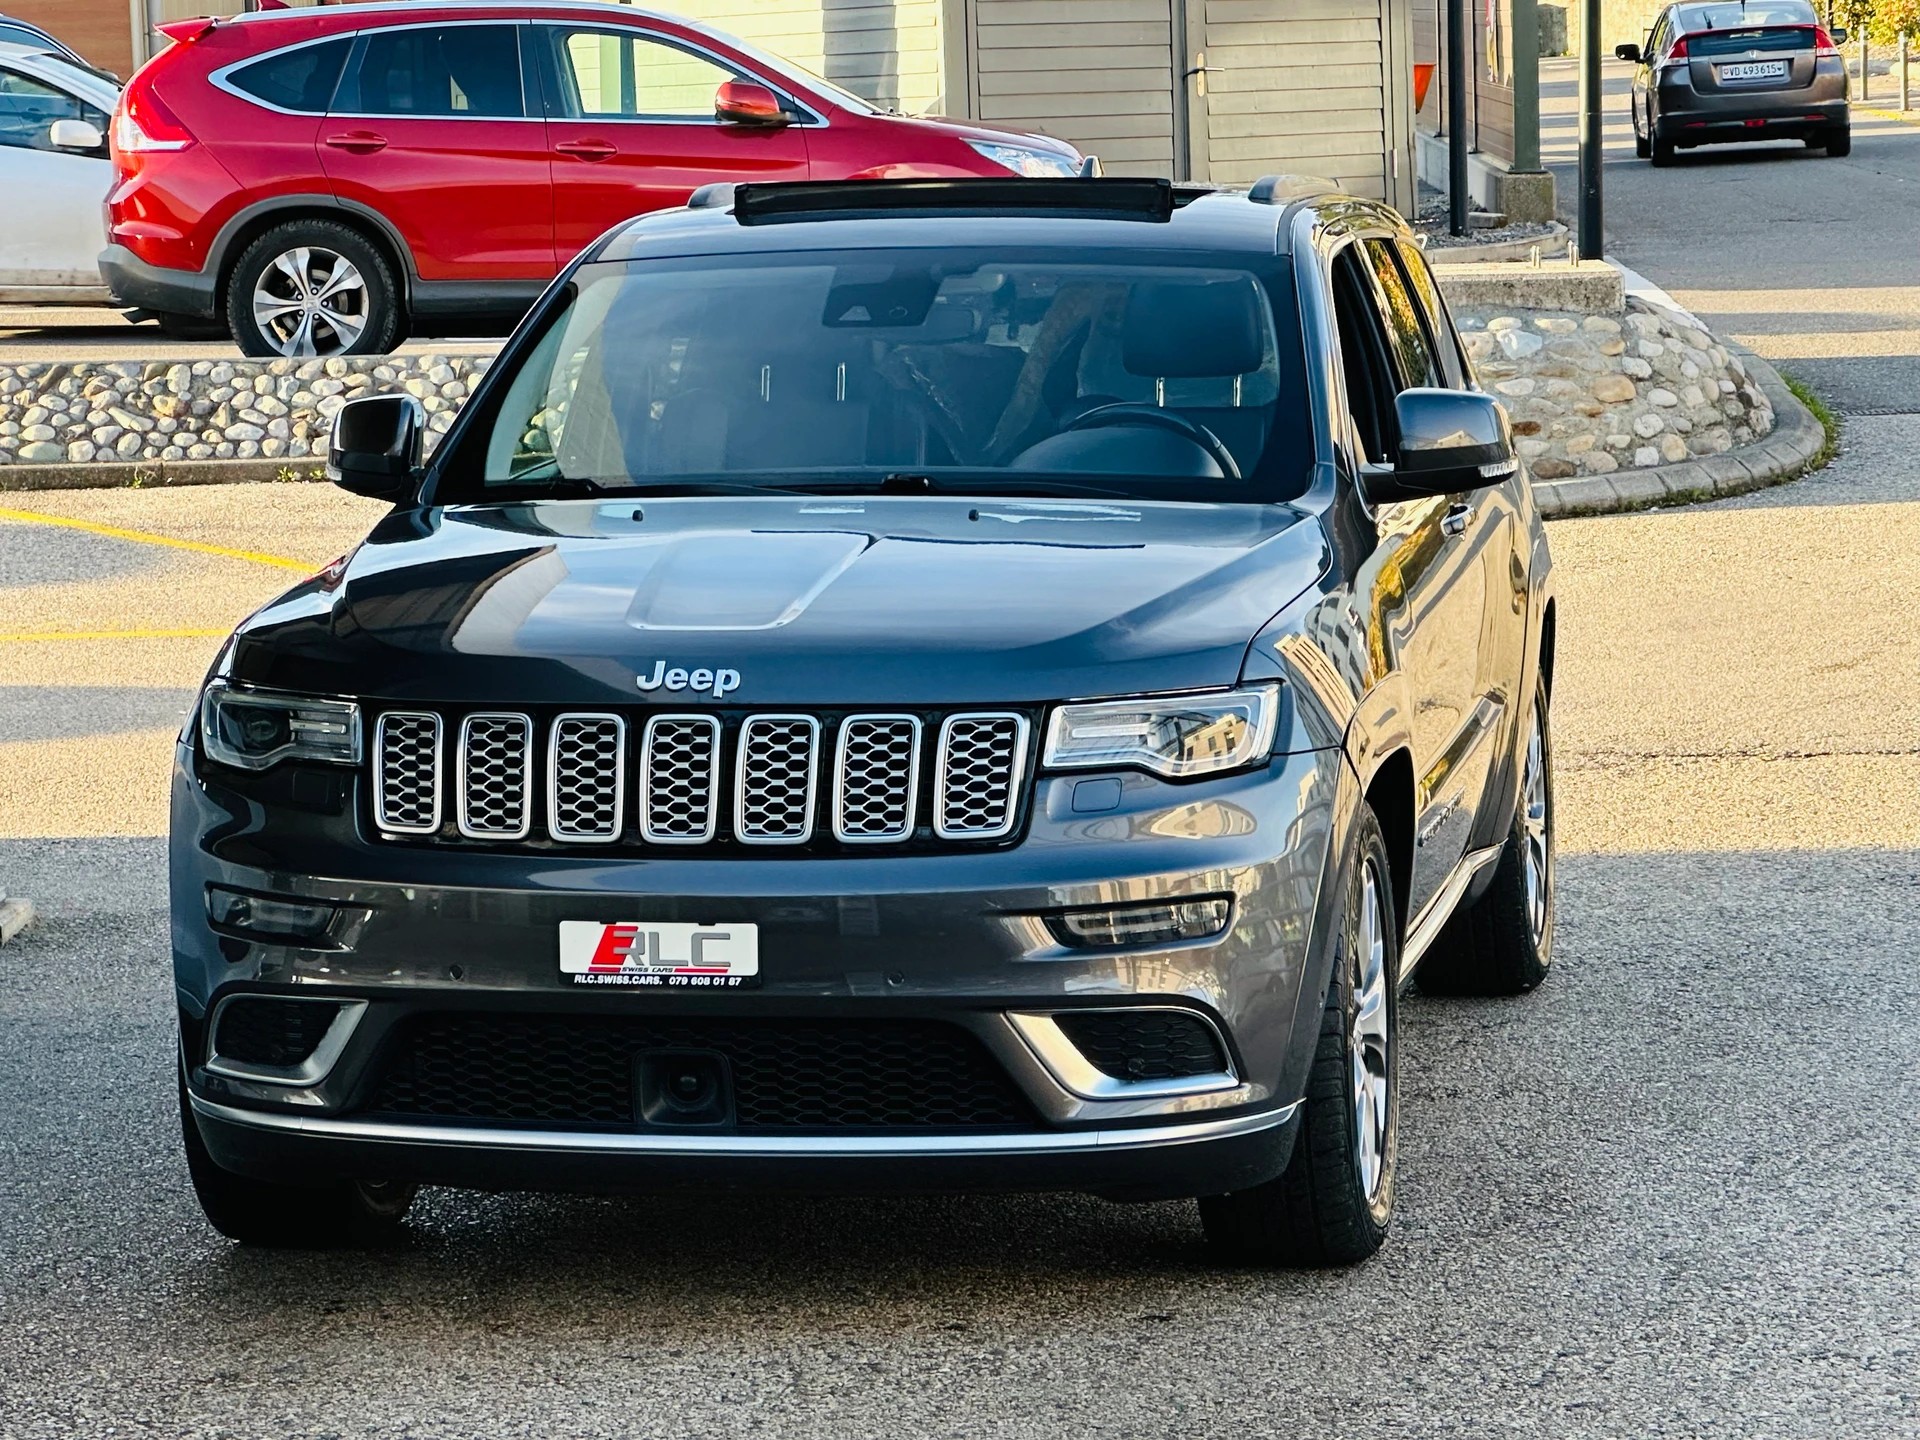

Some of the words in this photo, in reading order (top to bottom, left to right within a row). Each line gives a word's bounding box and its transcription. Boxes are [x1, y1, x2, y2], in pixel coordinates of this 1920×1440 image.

[1730, 66, 1740, 76] VD
[1743, 64, 1777, 75] 493615
[636, 660, 741, 698] Jeep
[574, 974, 663, 985] RLC.SWISS.CARS.
[668, 976, 688, 986] 079
[690, 977, 711, 986] 608
[713, 977, 725, 986] 01
[728, 977, 742, 986] 87
